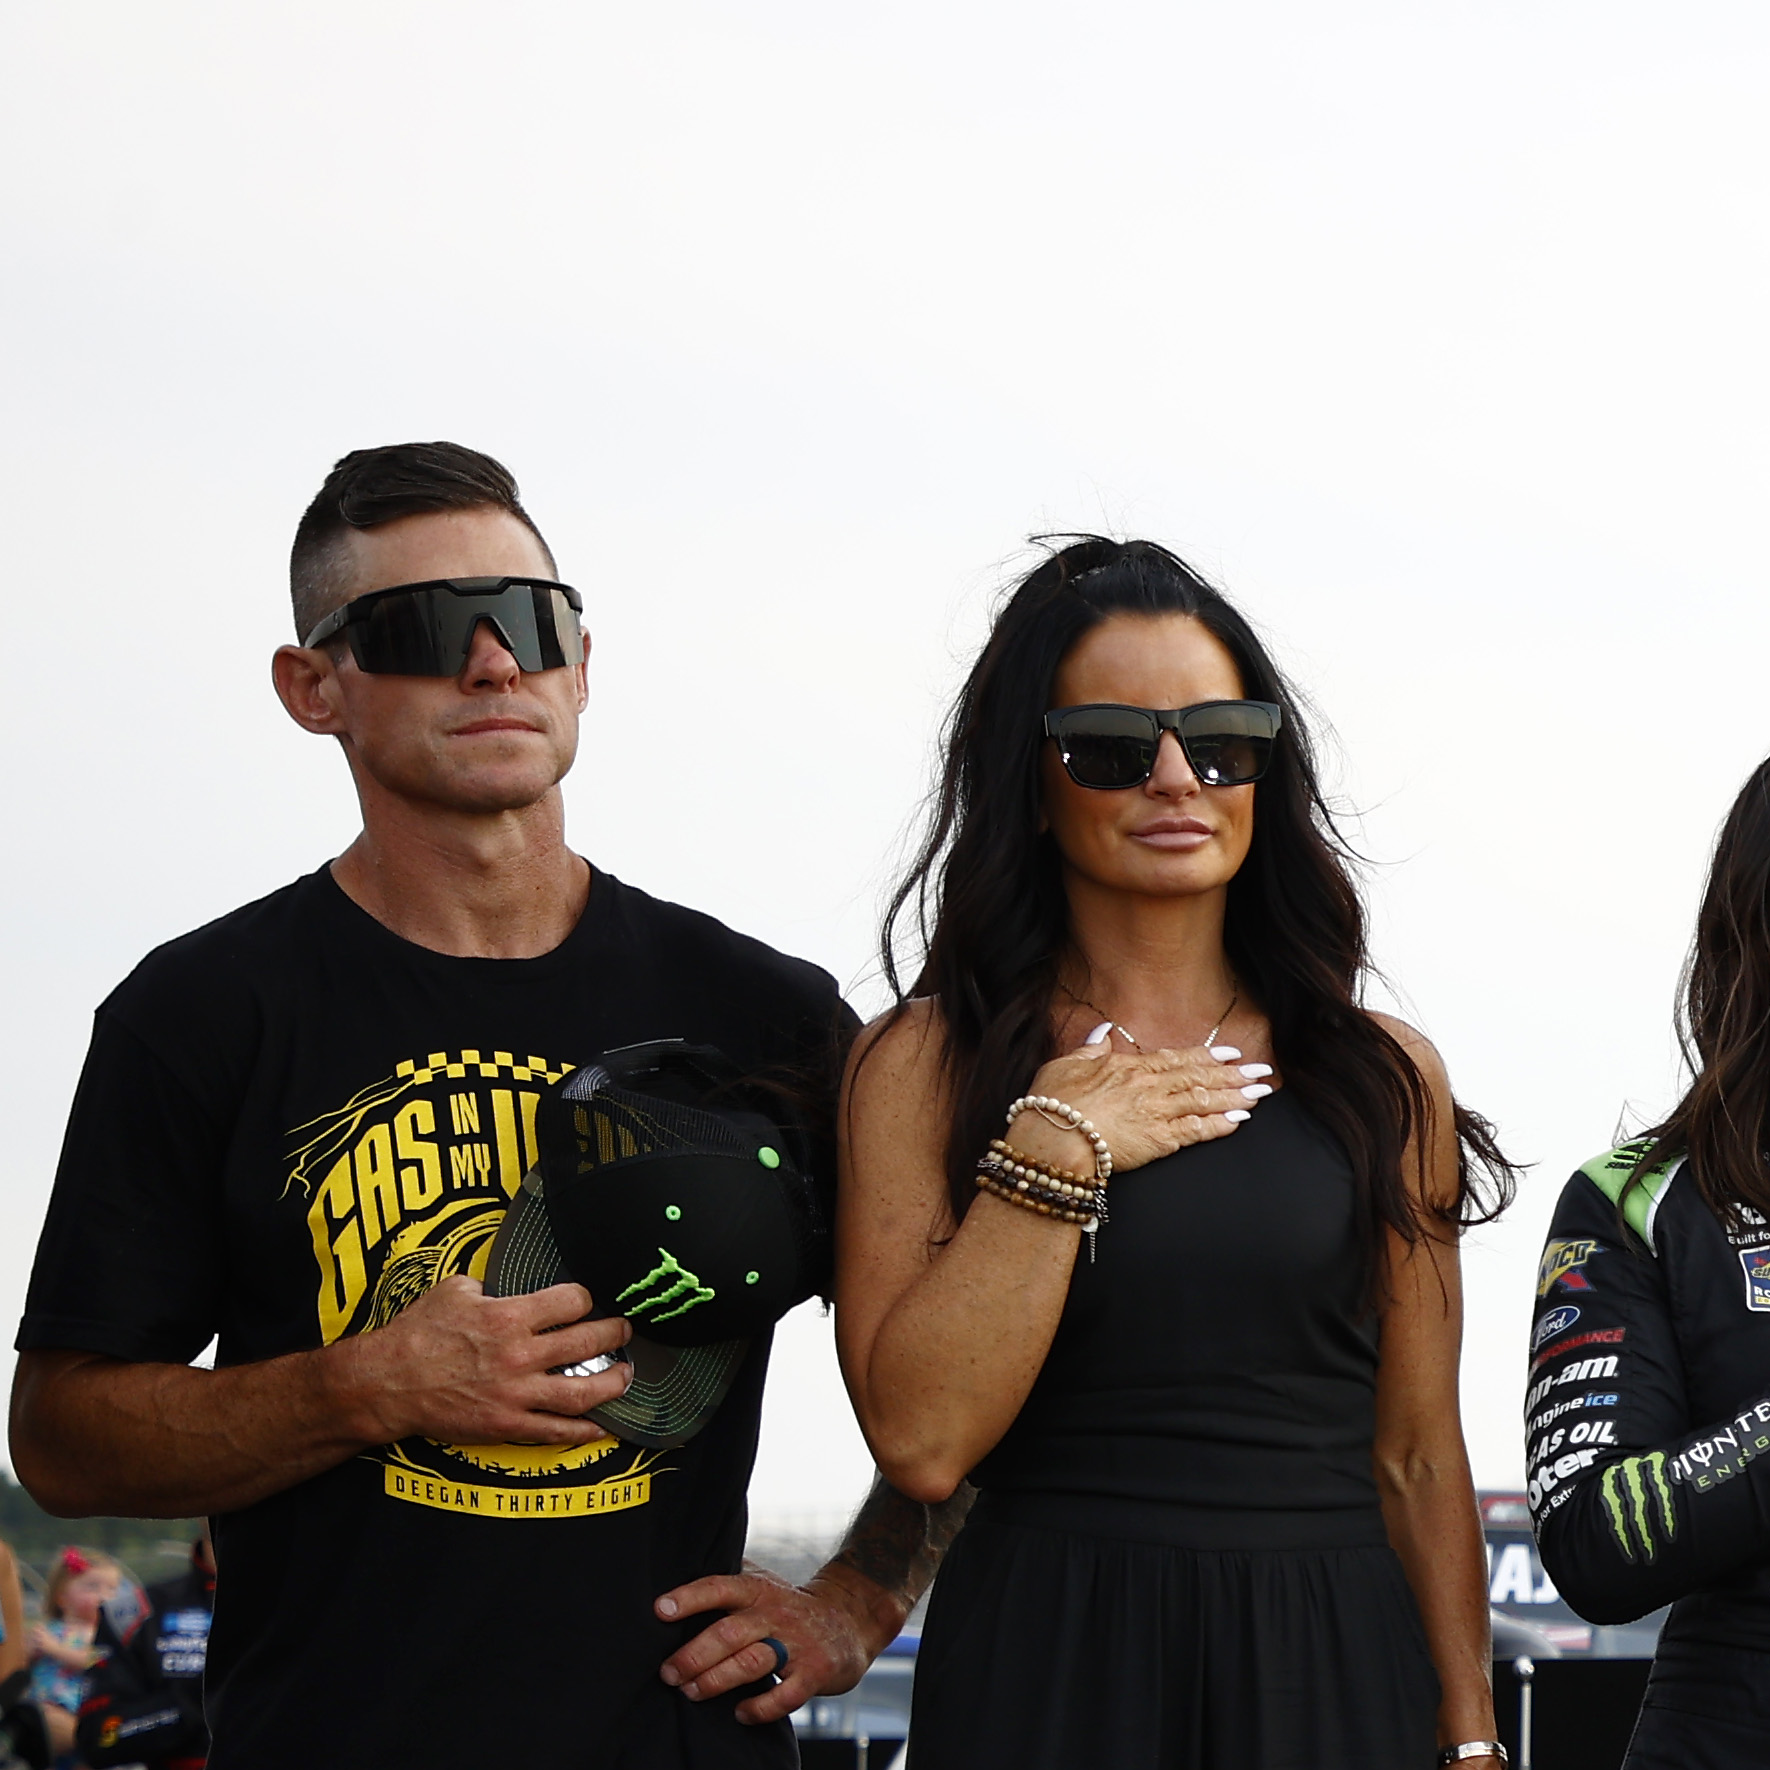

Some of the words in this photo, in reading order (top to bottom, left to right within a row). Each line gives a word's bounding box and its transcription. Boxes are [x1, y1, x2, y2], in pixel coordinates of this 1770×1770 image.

[449, 1092, 480, 1136] IN
[449, 1143, 490, 1189] MY
[307, 1099, 444, 1347] GAS
[1525, 1356, 1618, 1412] an-am
[1569, 1421, 1616, 1444] OIL
[396, 1475, 479, 1509] DEEGAN
[495, 1493, 573, 1512] THIRTY
[585, 1482, 644, 1509] EIGHT
[1528, 1448, 1600, 1512] oter
